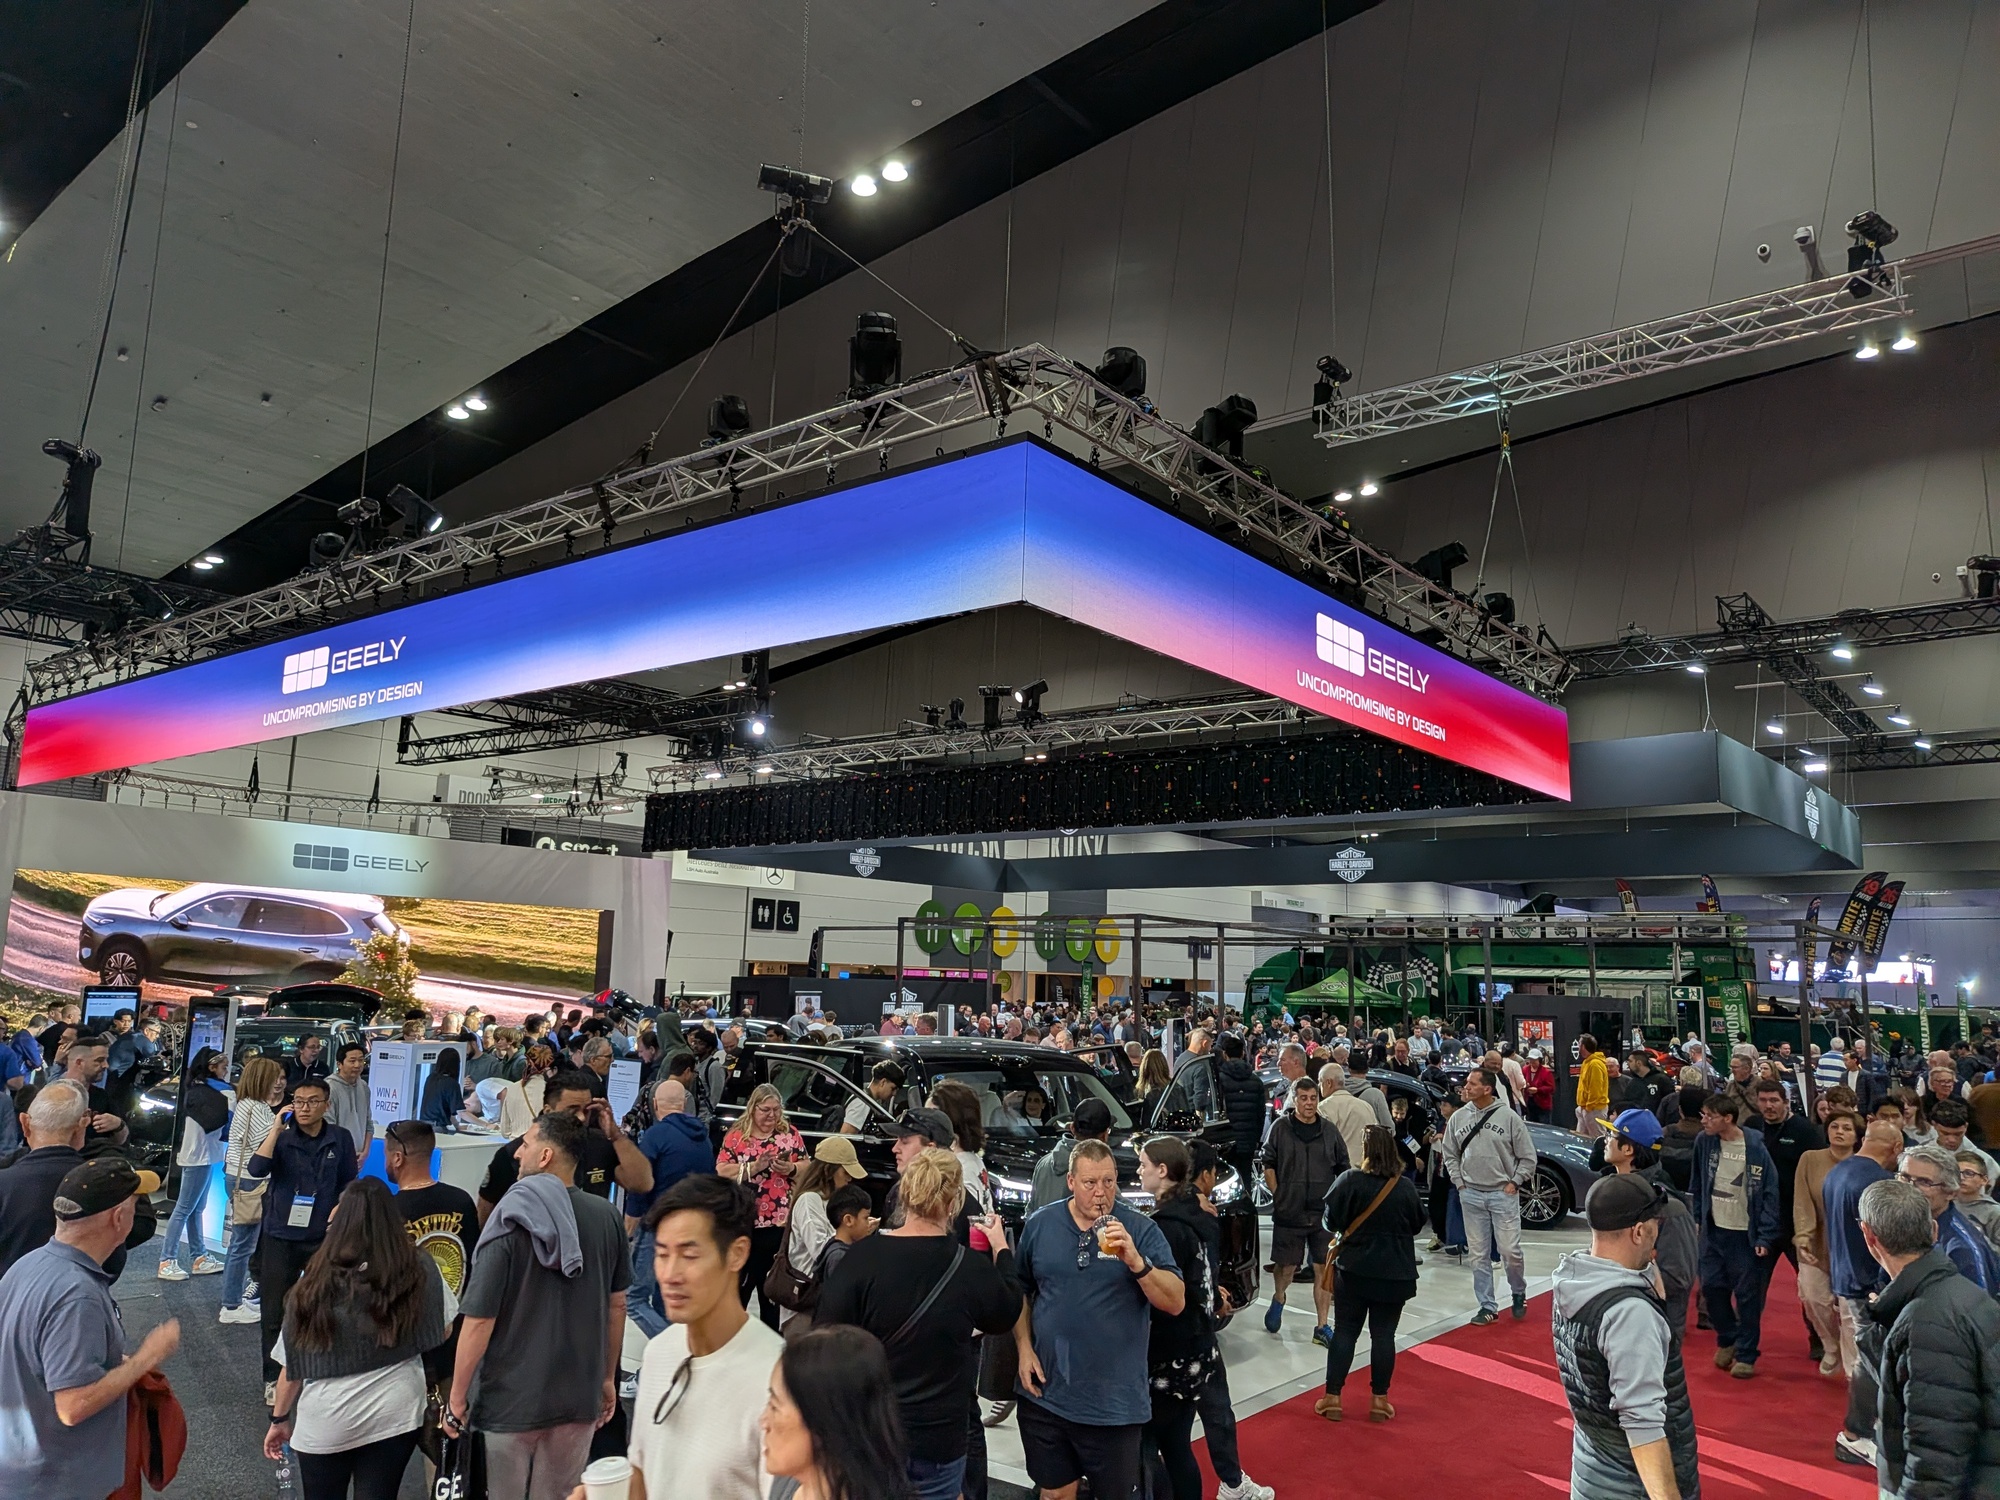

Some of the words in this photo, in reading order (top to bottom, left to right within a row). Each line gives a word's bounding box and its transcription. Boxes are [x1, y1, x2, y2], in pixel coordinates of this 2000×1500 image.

[331, 636, 407, 675] GEELY
[1368, 647, 1430, 694] GEELY
[263, 695, 357, 727] UNCOMPROMISING
[358, 690, 376, 708] BY
[377, 680, 423, 704] DESIGN
[1296, 669, 1396, 722] UNCOMPROMISING
[1396, 710, 1411, 728] BY
[1412, 716, 1446, 742] DESIGN
[354, 854, 430, 873] GEELY
[1340, 850, 1362, 858] MOTOR
[1331, 860, 1371, 868] HARLEY-DAVIDSON
[1340, 870, 1362, 880] CYCLES
[1863, 879, 1879, 896] 19
[1835, 900, 1863, 949] PNRITE
[1864, 908, 1884, 954] PENRITE
[1873, 925, 1886, 955] RACING
[1385, 970, 1420, 982] SHANONS
[376, 1086, 391, 1098] WIN
[391, 1088, 397, 1099] A
[375, 1100, 396, 1112] PRIZE
[1459, 1122, 1505, 1136] HILGER
[435, 1472, 464, 1500] GE
